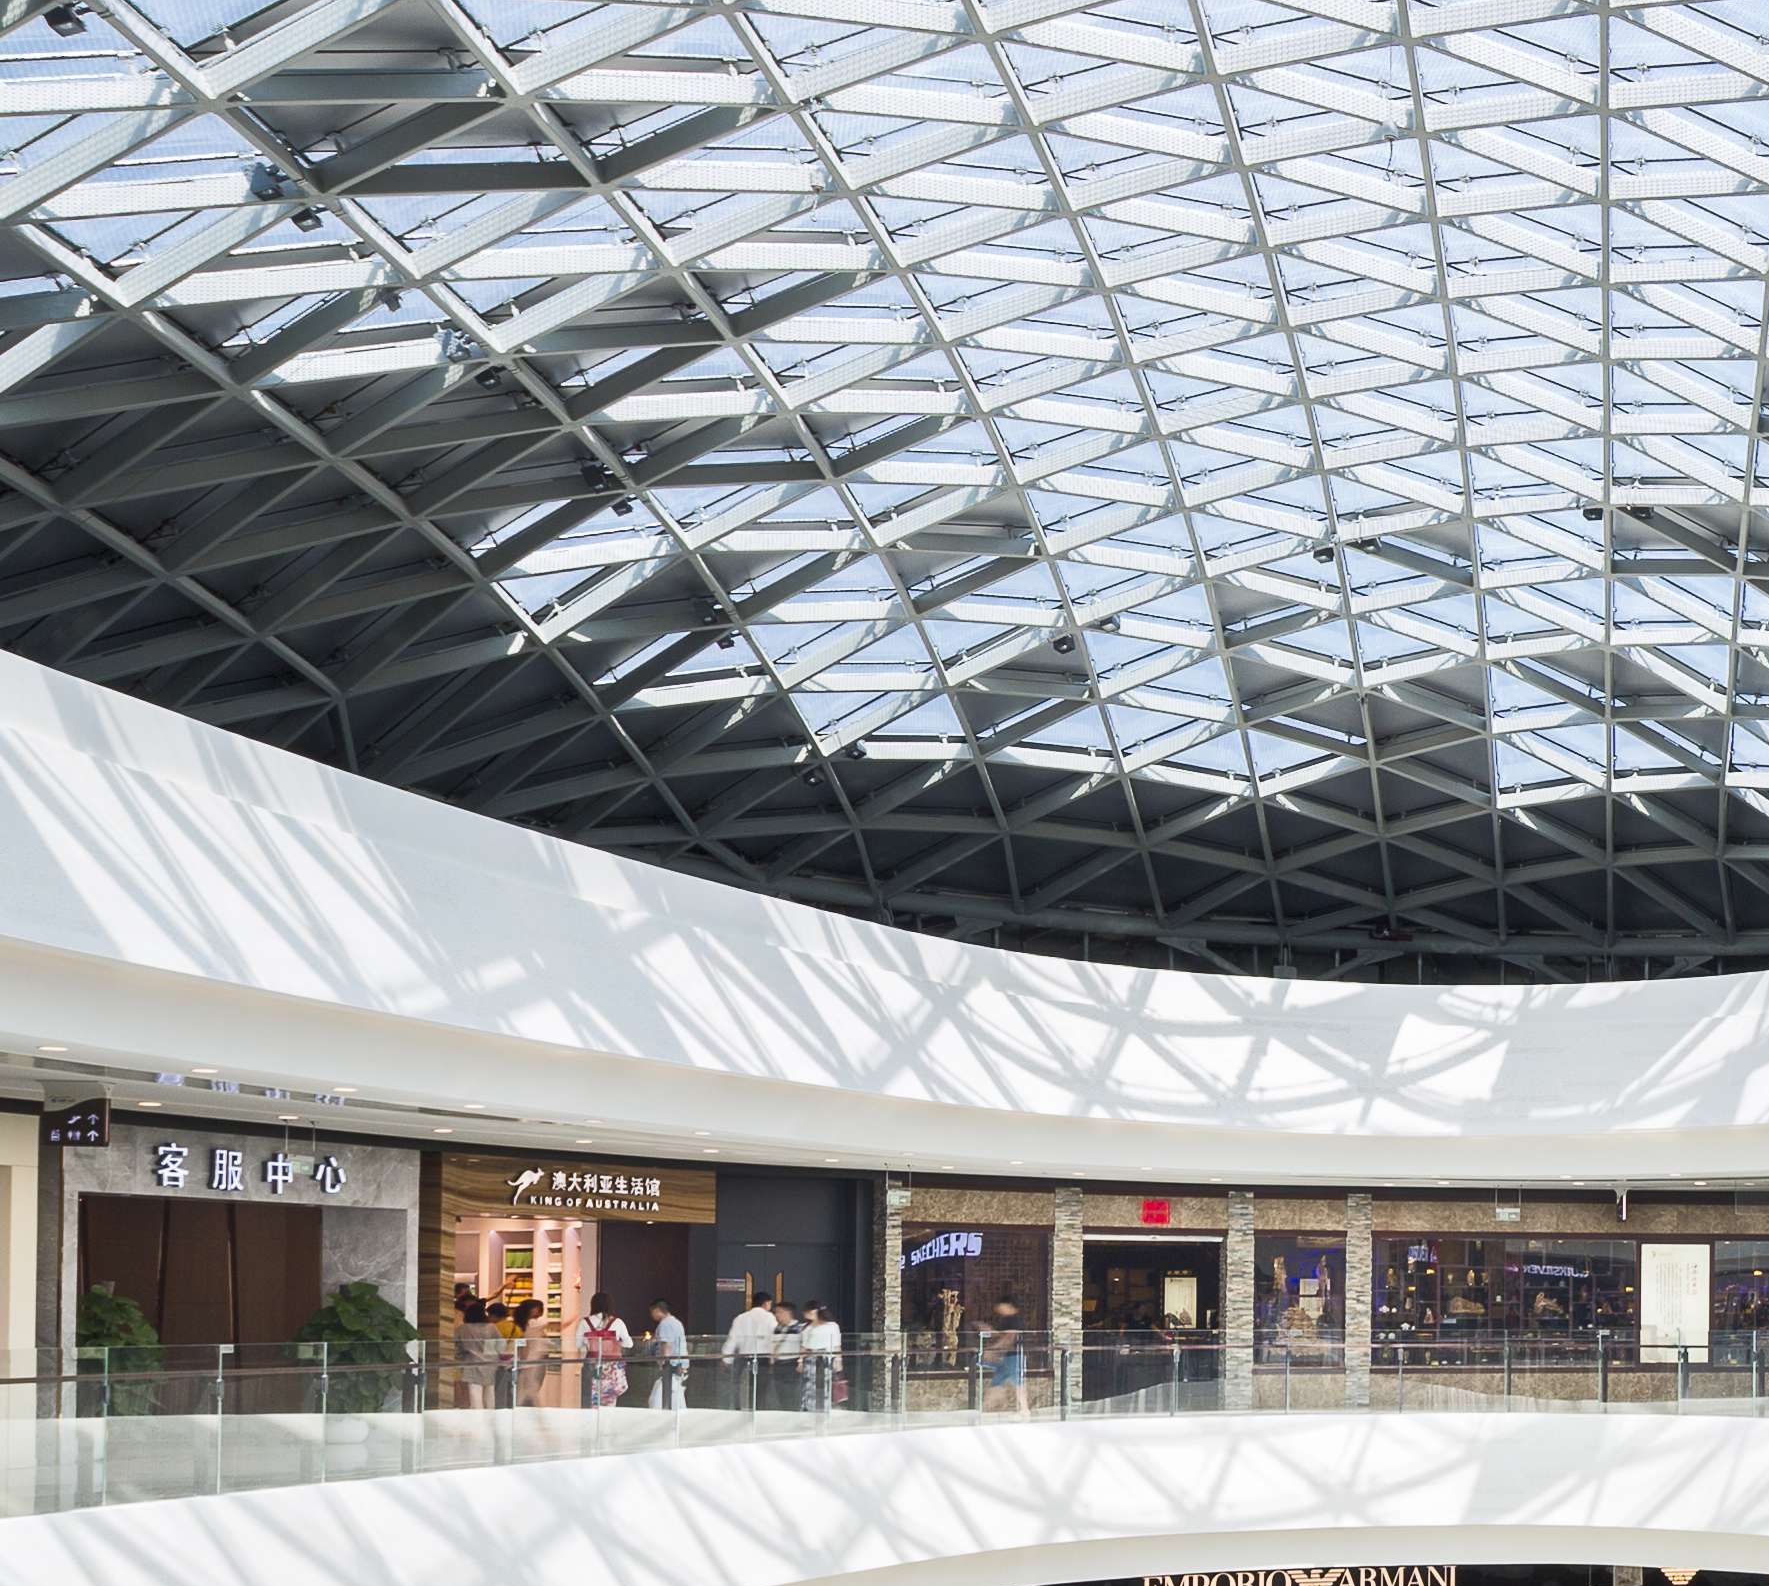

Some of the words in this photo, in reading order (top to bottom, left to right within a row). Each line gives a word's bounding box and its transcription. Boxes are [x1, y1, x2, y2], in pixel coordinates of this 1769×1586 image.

[157, 1142, 347, 1195] 客服中心
[552, 1171, 661, 1197] 澳大利亚生活馆
[530, 1195, 562, 1207] KING
[566, 1197, 582, 1208] OF
[585, 1198, 660, 1211] AUSTRALIA
